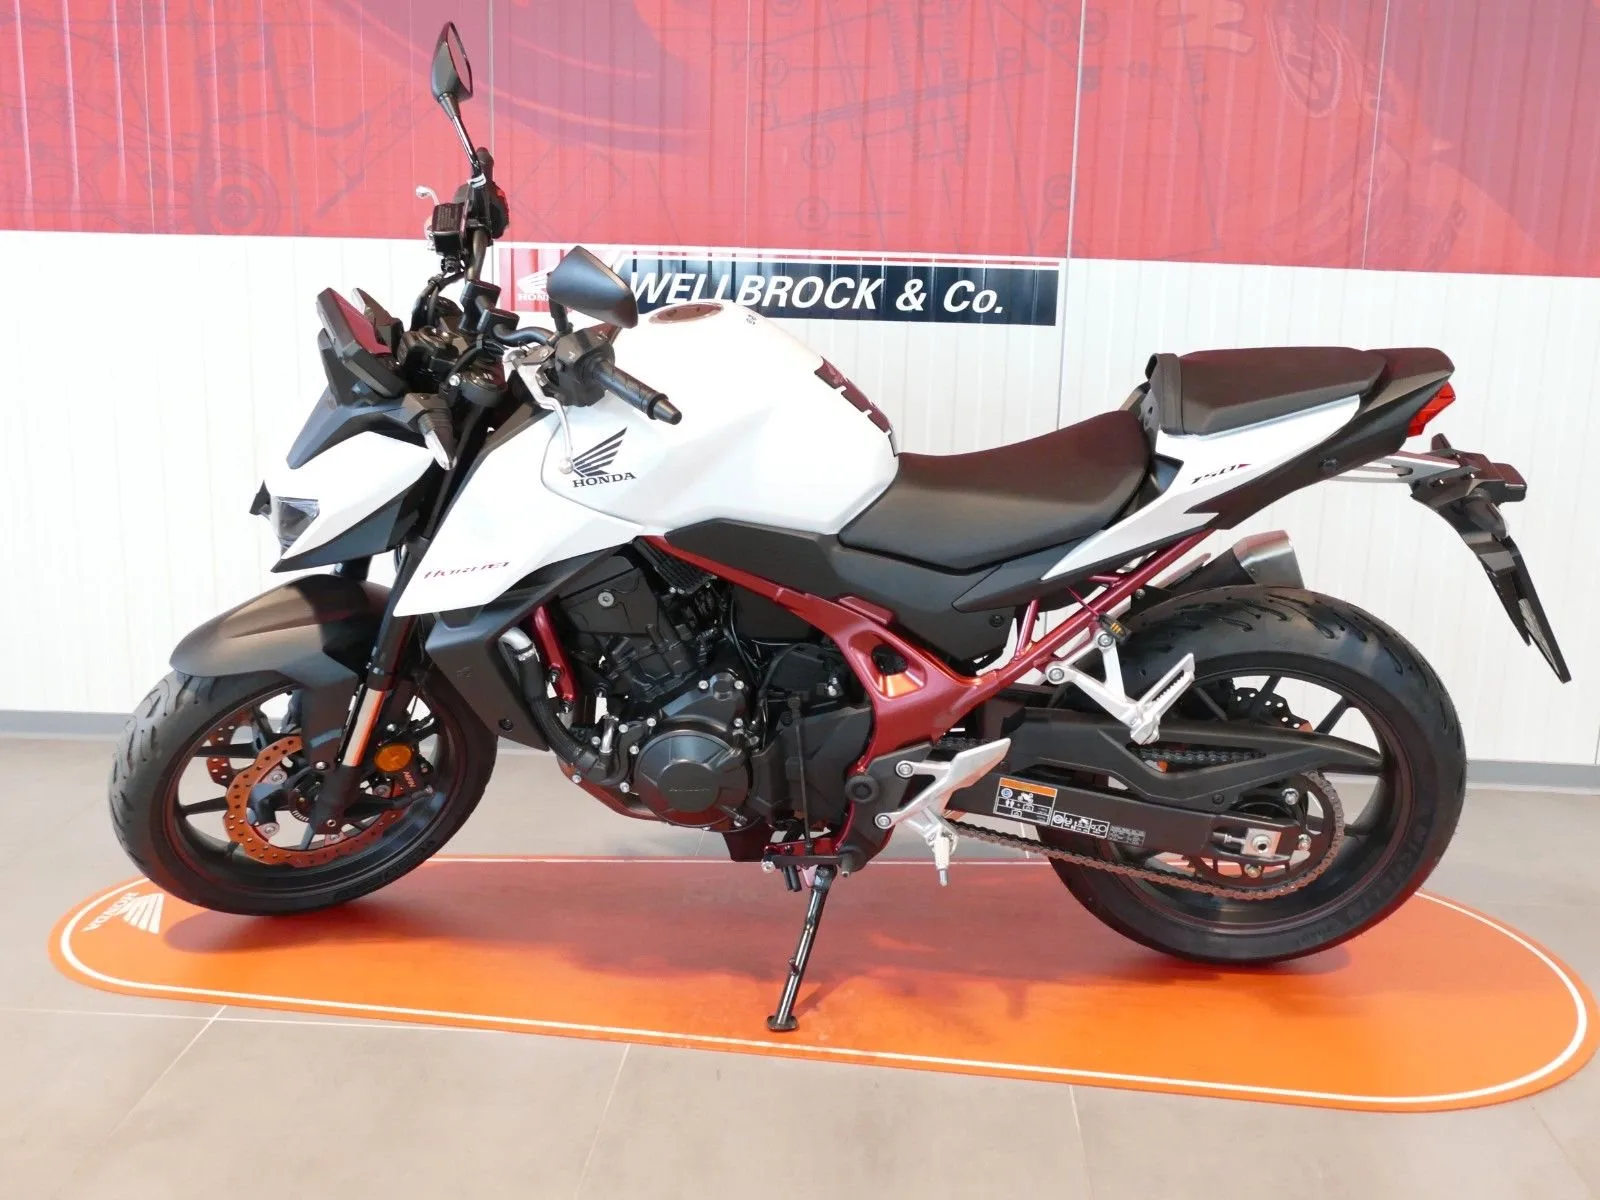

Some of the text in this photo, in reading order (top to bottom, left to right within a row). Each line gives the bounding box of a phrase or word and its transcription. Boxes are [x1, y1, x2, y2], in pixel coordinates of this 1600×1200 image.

[518, 293, 549, 302] HON
[630, 271, 1003, 314] WELLBROCK & Co.
[573, 472, 637, 488] HONDA
